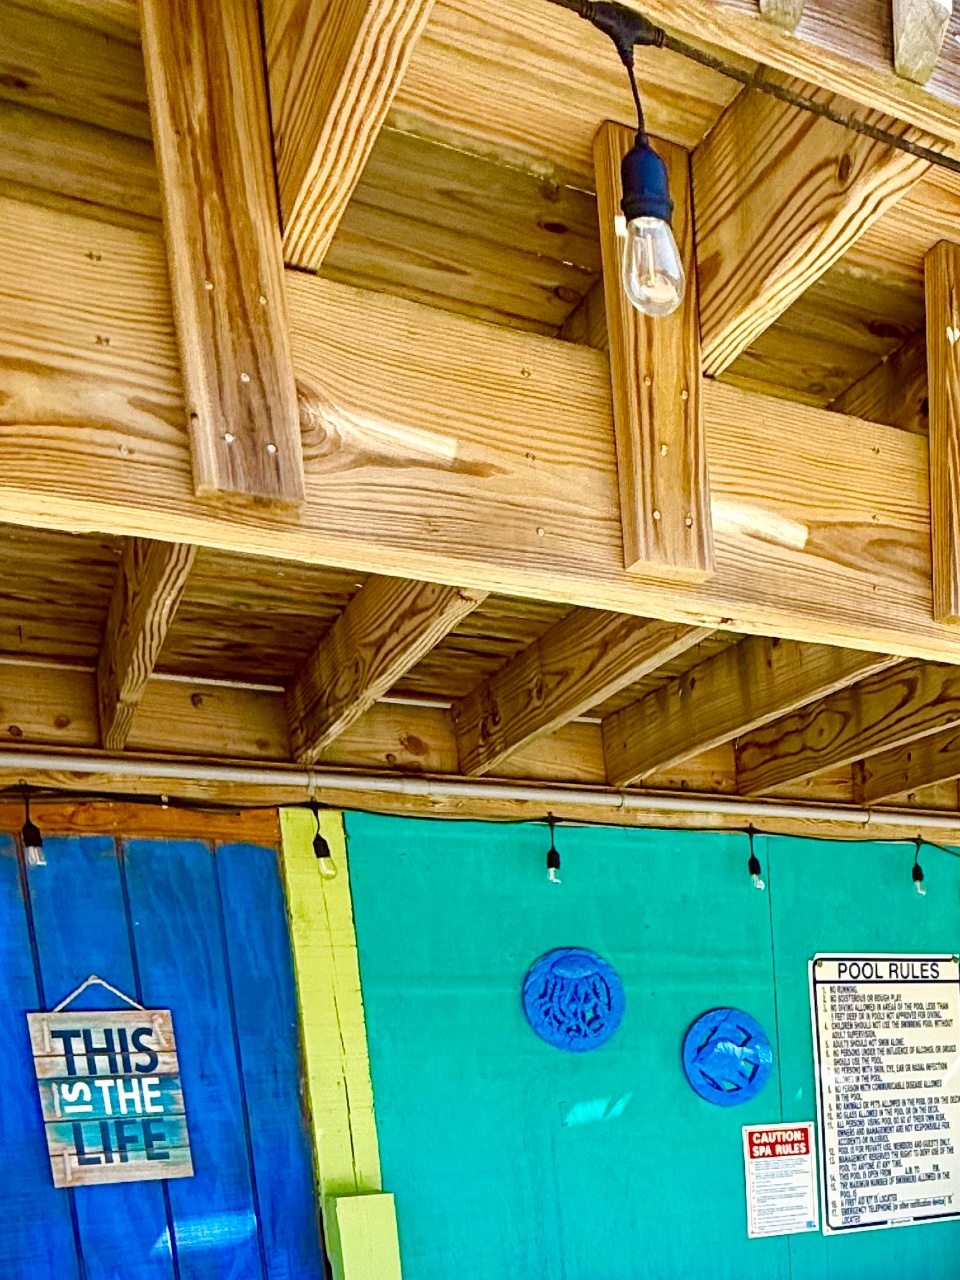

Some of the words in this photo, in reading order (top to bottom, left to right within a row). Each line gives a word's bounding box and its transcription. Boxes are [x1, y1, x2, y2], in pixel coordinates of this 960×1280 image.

[838, 962, 883, 979] POOL
[889, 962, 940, 979] RULES
[51, 1027, 159, 1076] THIS
[61, 1081, 93, 1113] IS
[95, 1077, 164, 1115] THE
[72, 1117, 170, 1165] LIFE
[752, 1130, 805, 1144] CAUTION:
[752, 1145, 773, 1157] SPA
[775, 1143, 806, 1155] RULES
